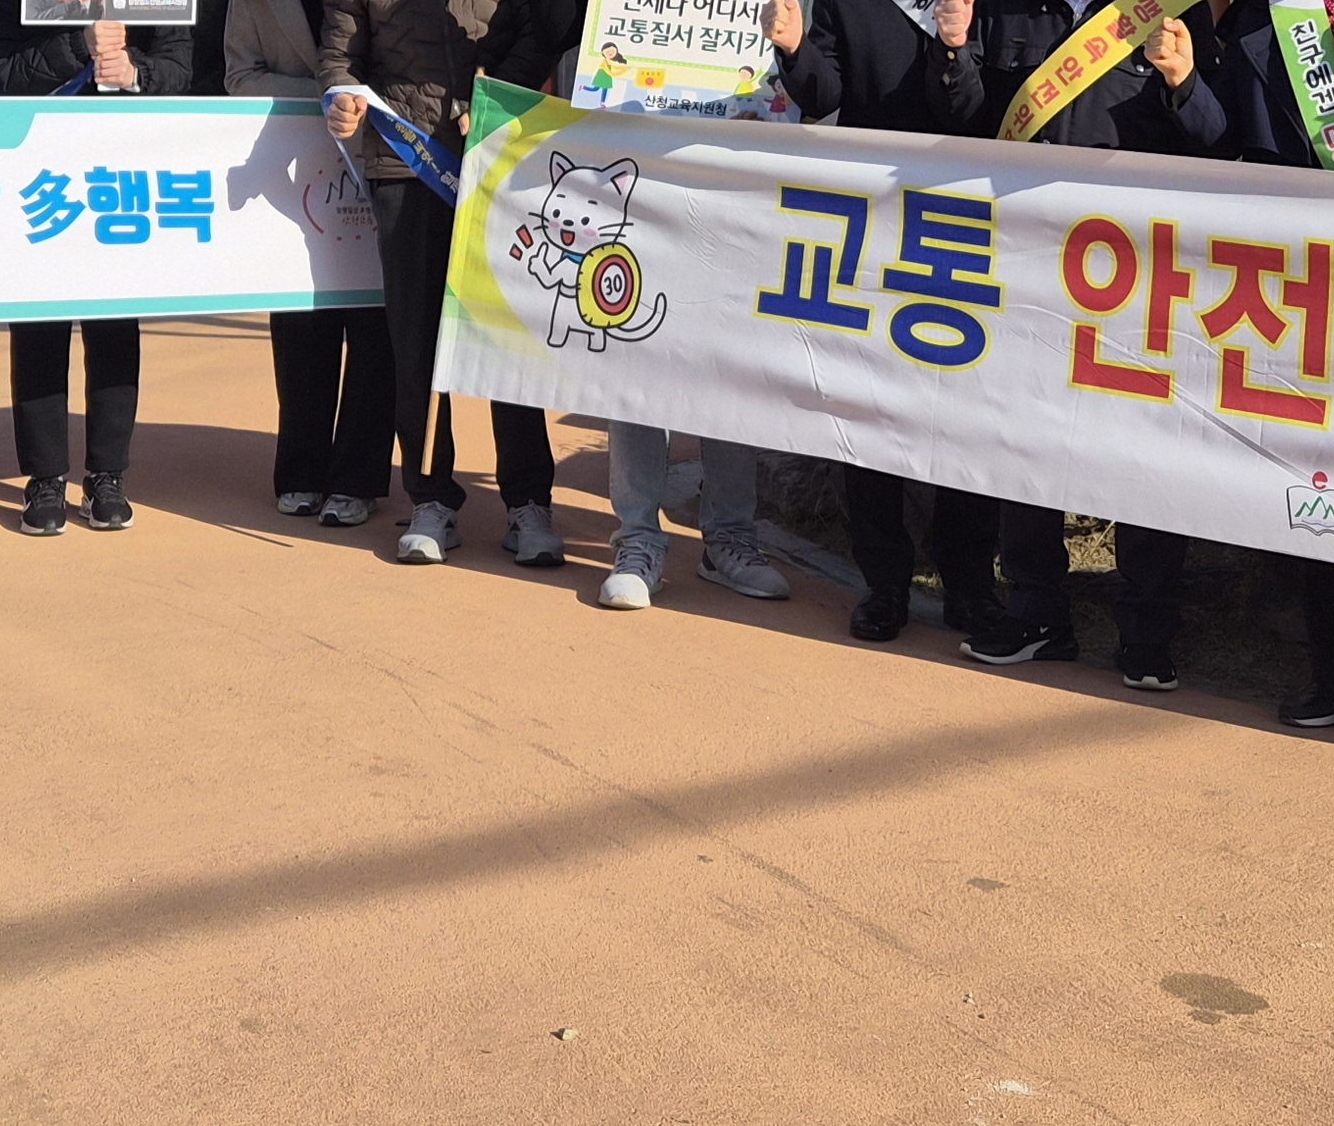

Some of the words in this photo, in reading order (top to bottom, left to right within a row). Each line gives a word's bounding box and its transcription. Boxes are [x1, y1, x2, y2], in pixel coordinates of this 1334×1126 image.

[604, 16, 694, 49] 교통질서
[699, 25, 775, 58] 잘지키
[645, 95, 727, 116] 산청교육지원청
[19, 166, 215, 244] 多행복
[603, 273, 623, 296] 30
[756, 184, 1005, 369] 교통
